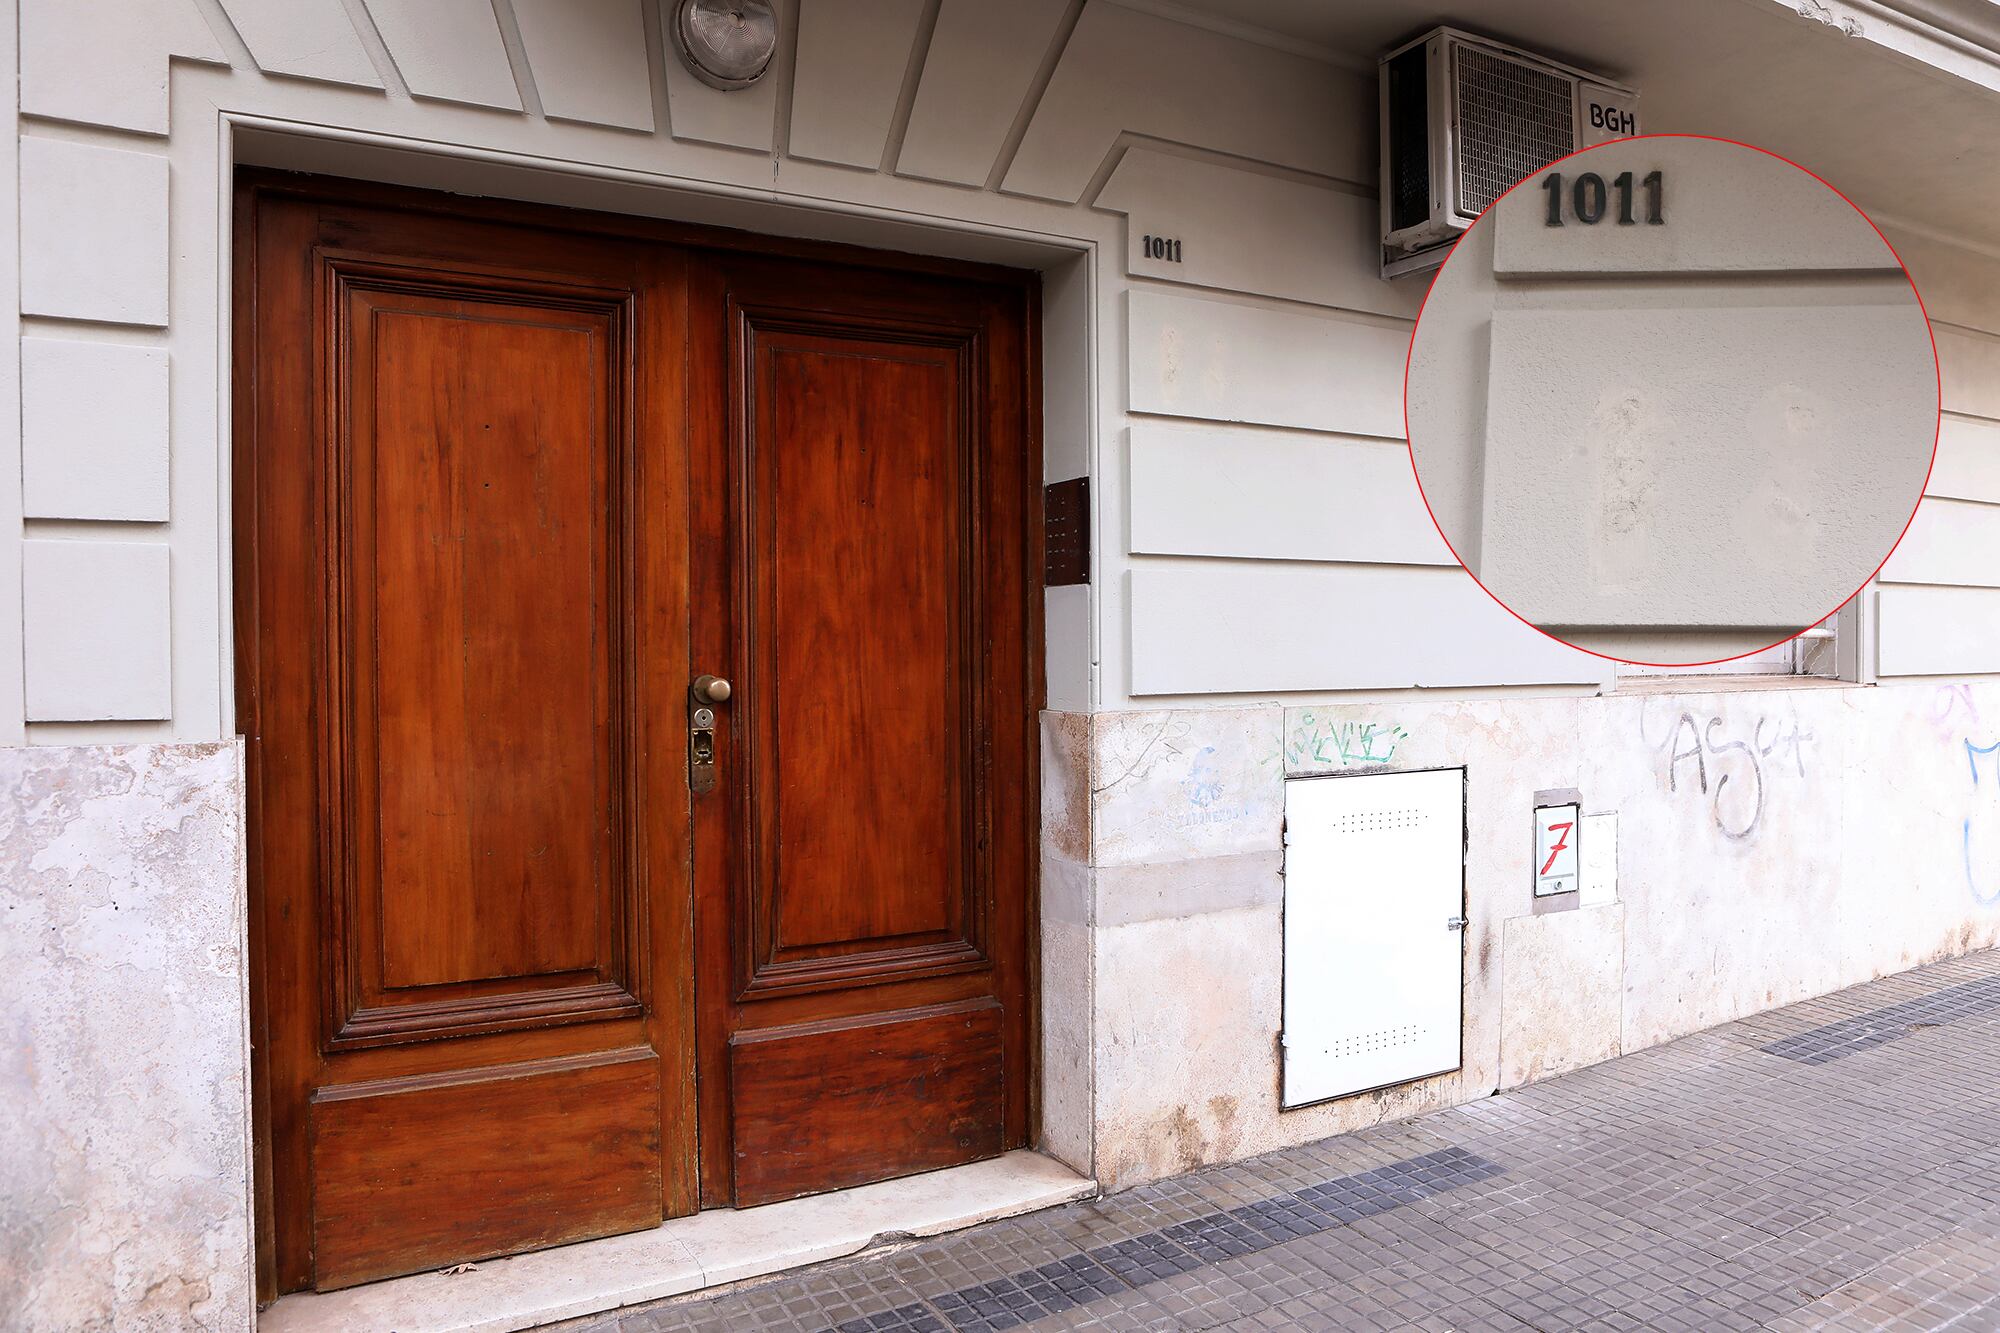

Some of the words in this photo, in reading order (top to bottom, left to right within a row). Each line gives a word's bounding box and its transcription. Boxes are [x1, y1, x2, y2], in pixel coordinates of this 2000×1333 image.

[1590, 103, 1635, 136] BGH
[1542, 171, 1665, 227] 1011
[1143, 234, 1182, 263] 1011
[1540, 821, 1574, 876] 7
